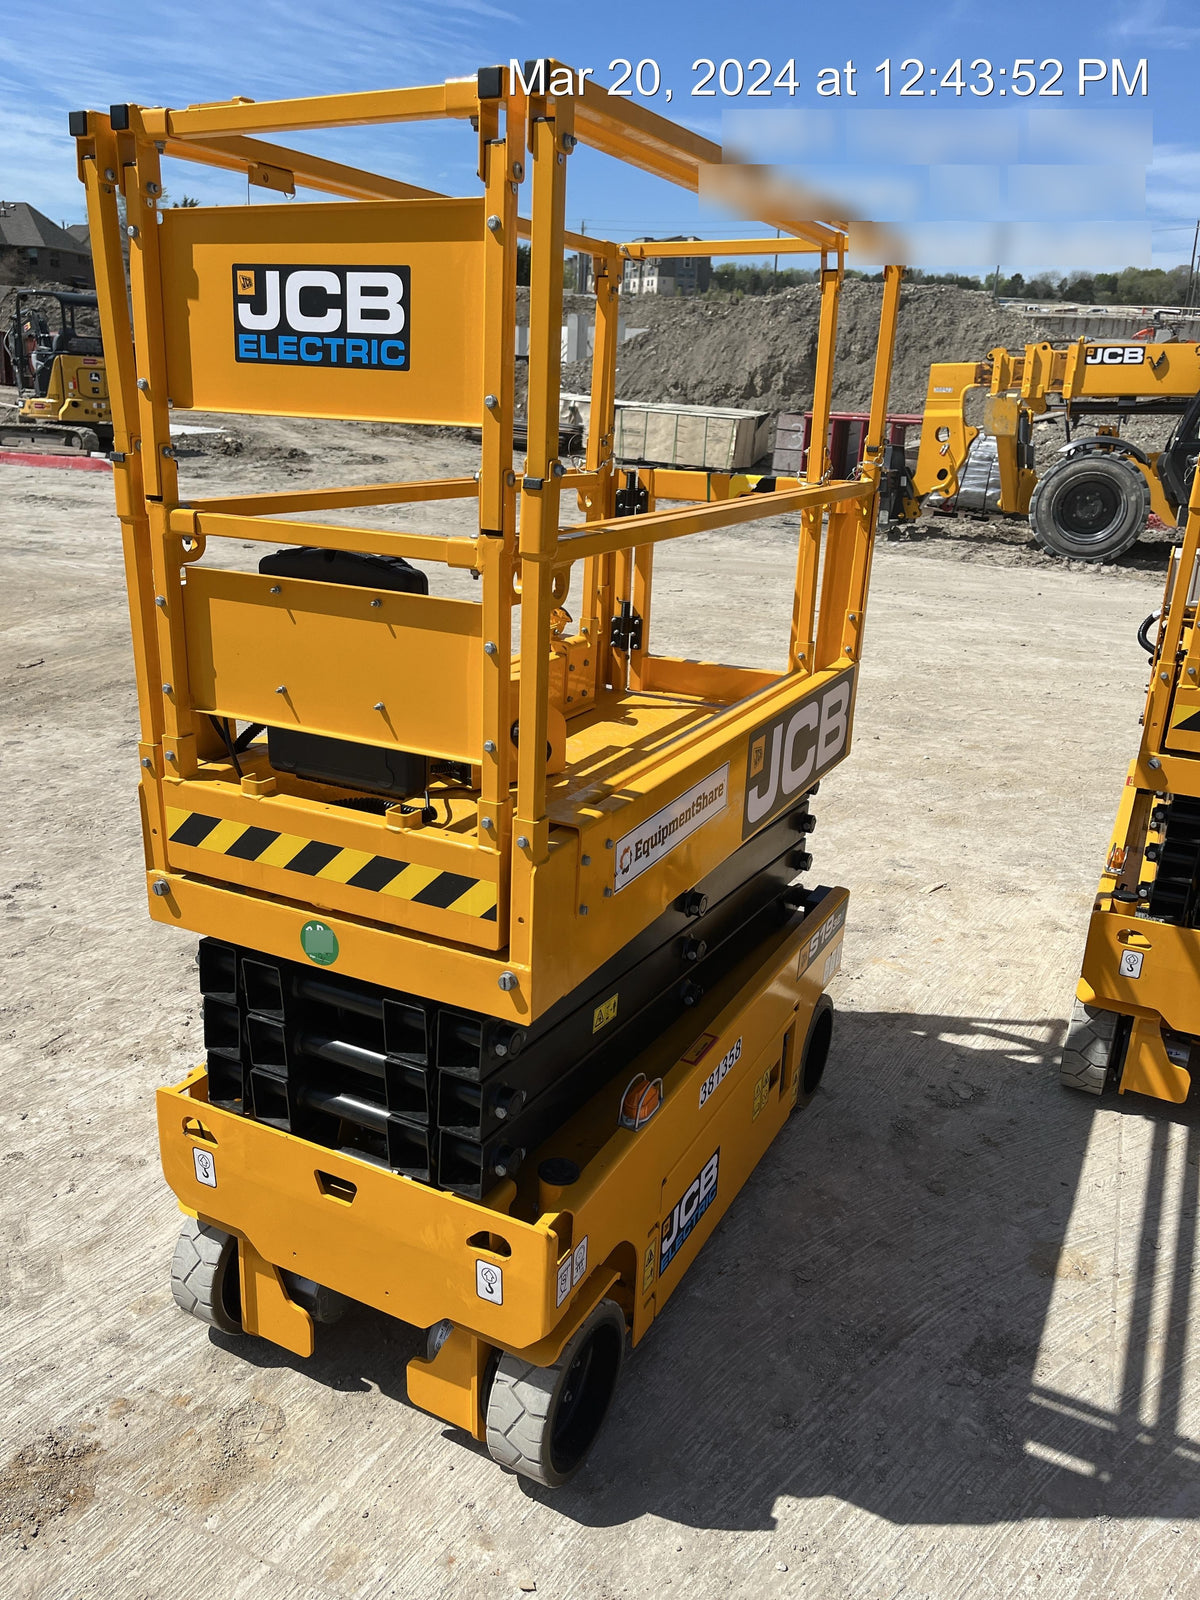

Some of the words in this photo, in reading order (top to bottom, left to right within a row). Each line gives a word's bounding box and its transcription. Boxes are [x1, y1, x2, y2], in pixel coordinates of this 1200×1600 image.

[238, 270, 405, 335] JCB
[238, 333, 406, 366] ELECTRIC
[1086, 347, 1144, 364] JCB
[747, 680, 850, 824] JCB
[634, 782, 725, 862] EquipmentShare
[700, 1038, 742, 1105] 381358
[660, 1183, 717, 1274] ELECTRIC
[661, 1153, 719, 1255] JCB
